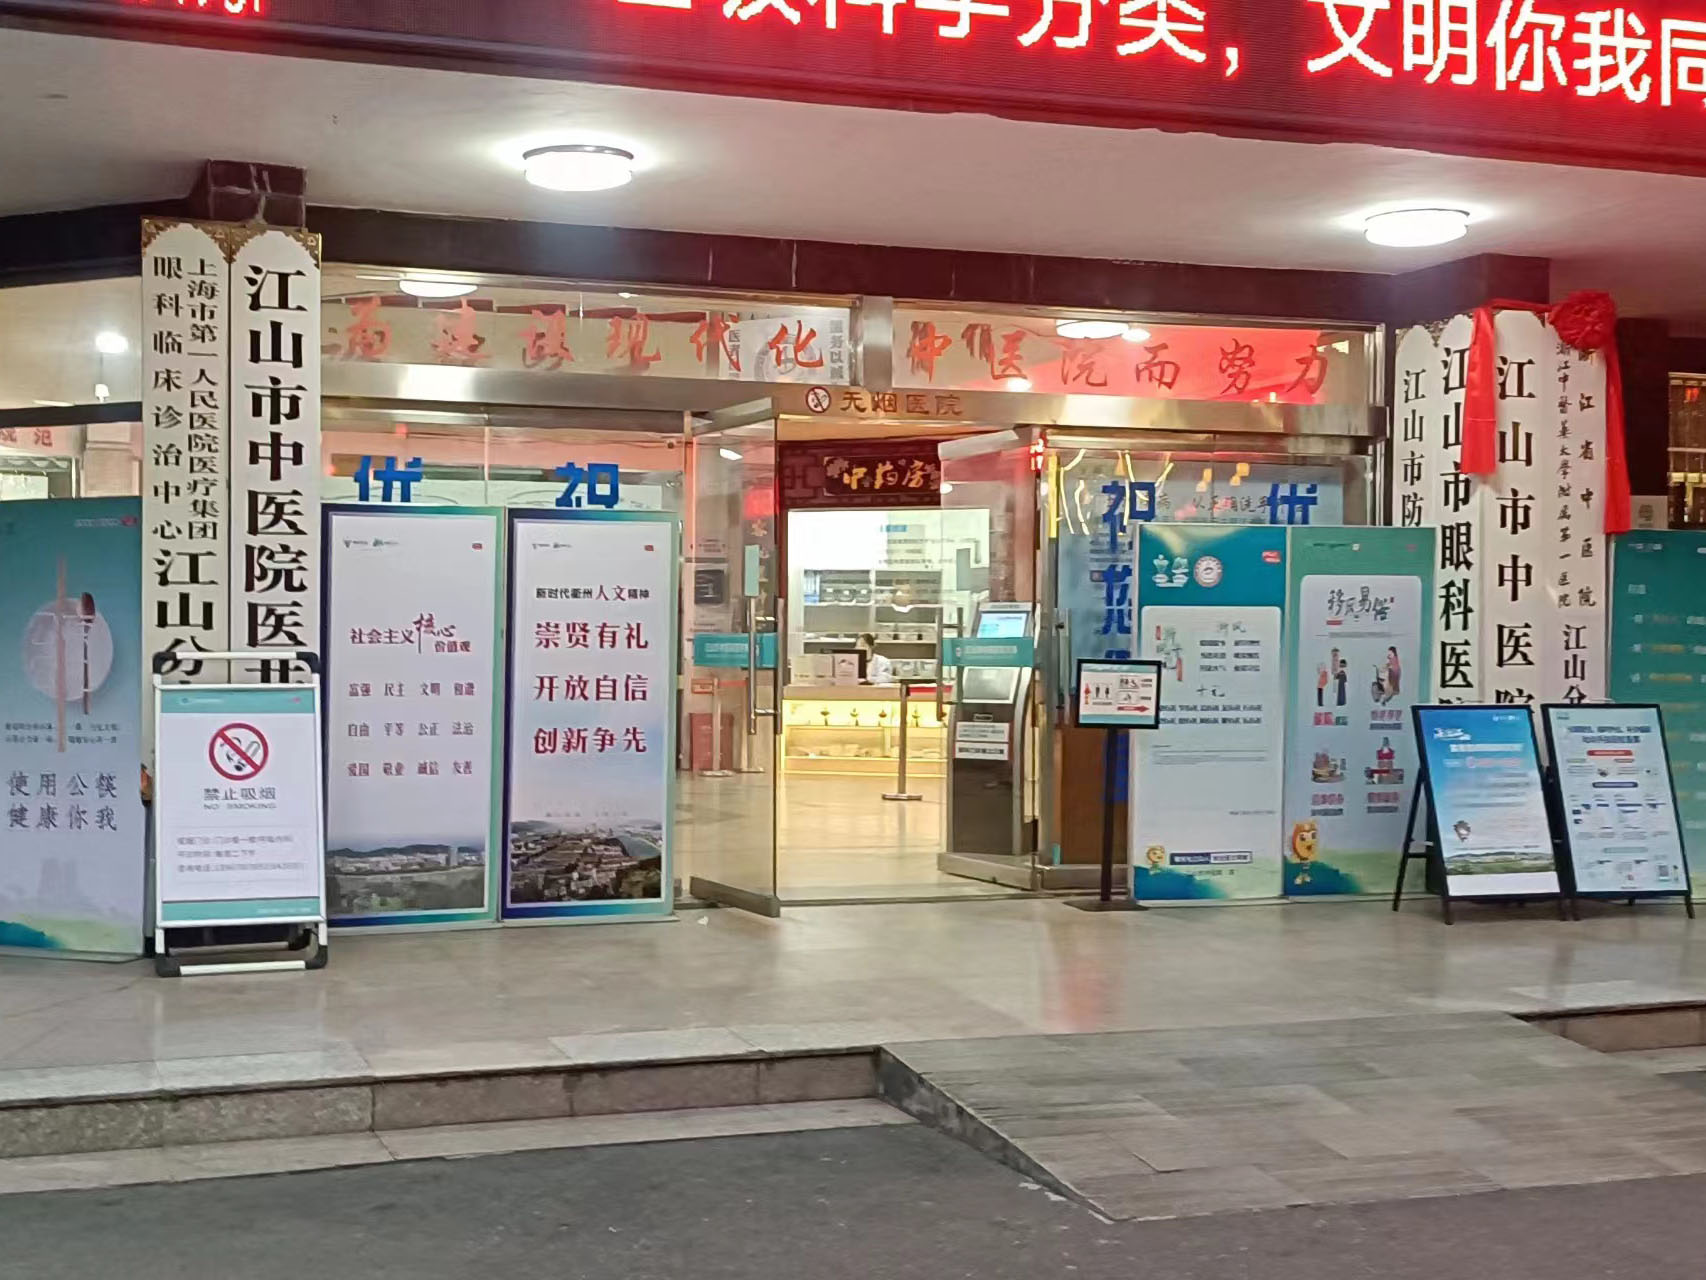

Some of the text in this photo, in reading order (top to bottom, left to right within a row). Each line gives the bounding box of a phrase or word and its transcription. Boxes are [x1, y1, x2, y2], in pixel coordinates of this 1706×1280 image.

[152, 255, 183, 540] 眼科临床诊治中心
[187, 257, 220, 541] 上海市第一人民医院医疗集团
[840, 391, 963, 416] 无烟医院
[1400, 368, 1427, 527] 江山市防
[843, 460, 926, 491] 中药房
[1439, 346, 1477, 704] 江山市眼科医
[154, 548, 219, 684] 江山分
[534, 621, 649, 649] 崇贤有礼
[534, 674, 649, 702] 开放自信
[534, 727, 648, 754] 创新争先
[203, 787, 277, 801] 禁止吸烟
